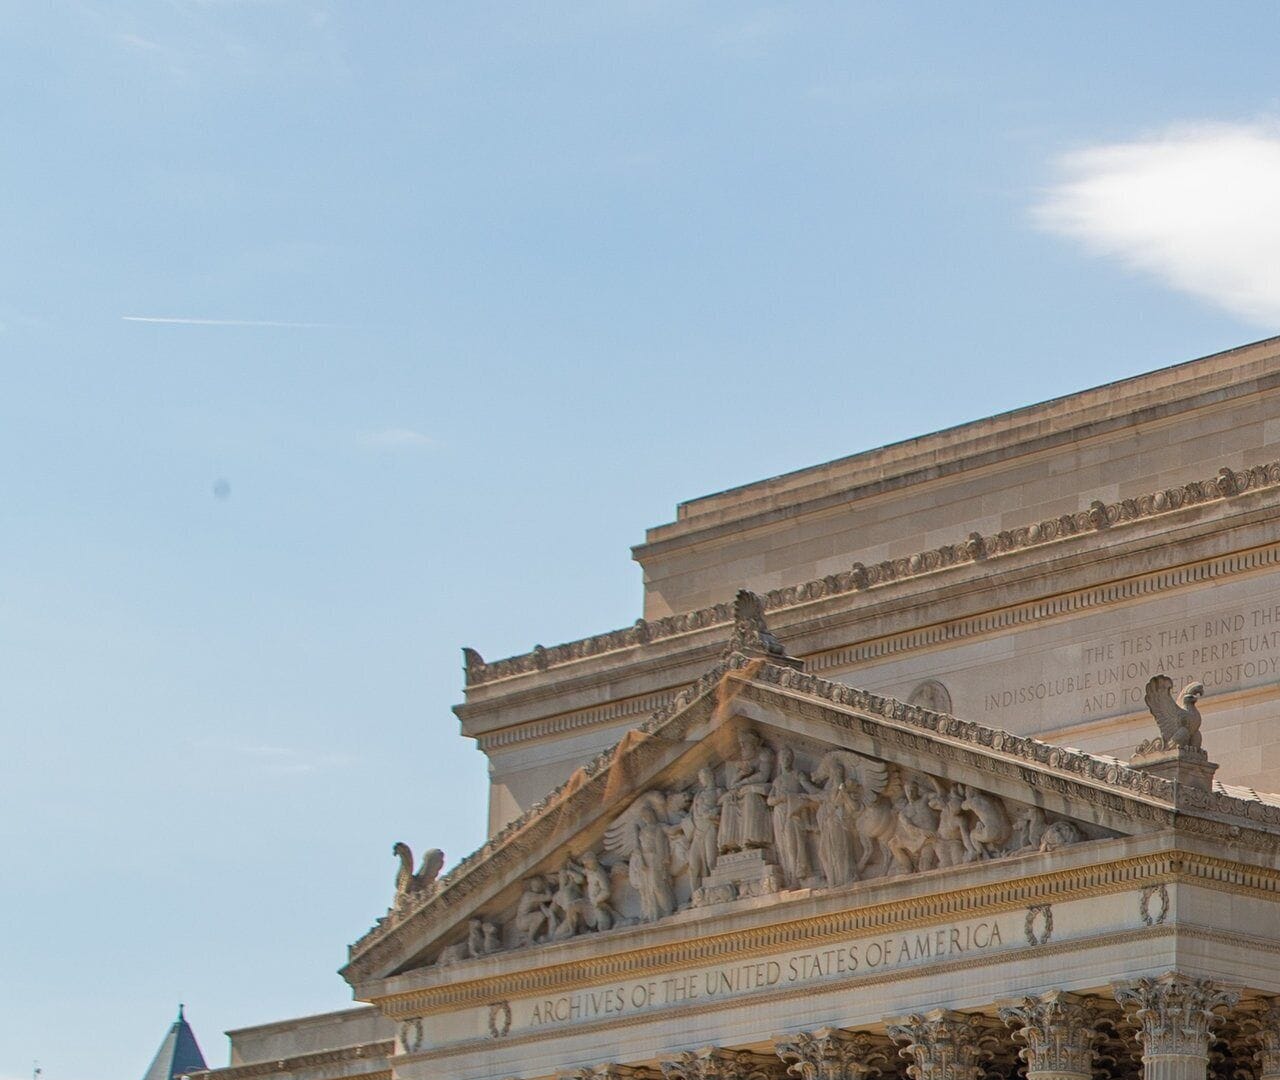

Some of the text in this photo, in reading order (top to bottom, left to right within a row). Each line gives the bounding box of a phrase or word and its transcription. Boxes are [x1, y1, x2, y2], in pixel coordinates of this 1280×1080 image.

[1085, 647, 1115, 665] THE
[1121, 635, 1152, 656] TIES
[1158, 624, 1199, 648] THAT
[1204, 614, 1246, 638] BIND
[984, 673, 1091, 712] INDISSOLUBLE
[1097, 660, 1150, 686] UNION
[1155, 652, 1185, 673] ARE
[1082, 692, 1116, 714] AND
[1121, 686, 1142, 705] TO
[1202, 656, 1280, 688] CUSTODY
[530, 920, 1003, 1027] ARCHIVES OF THE UNITED STATES OF AMERICA
